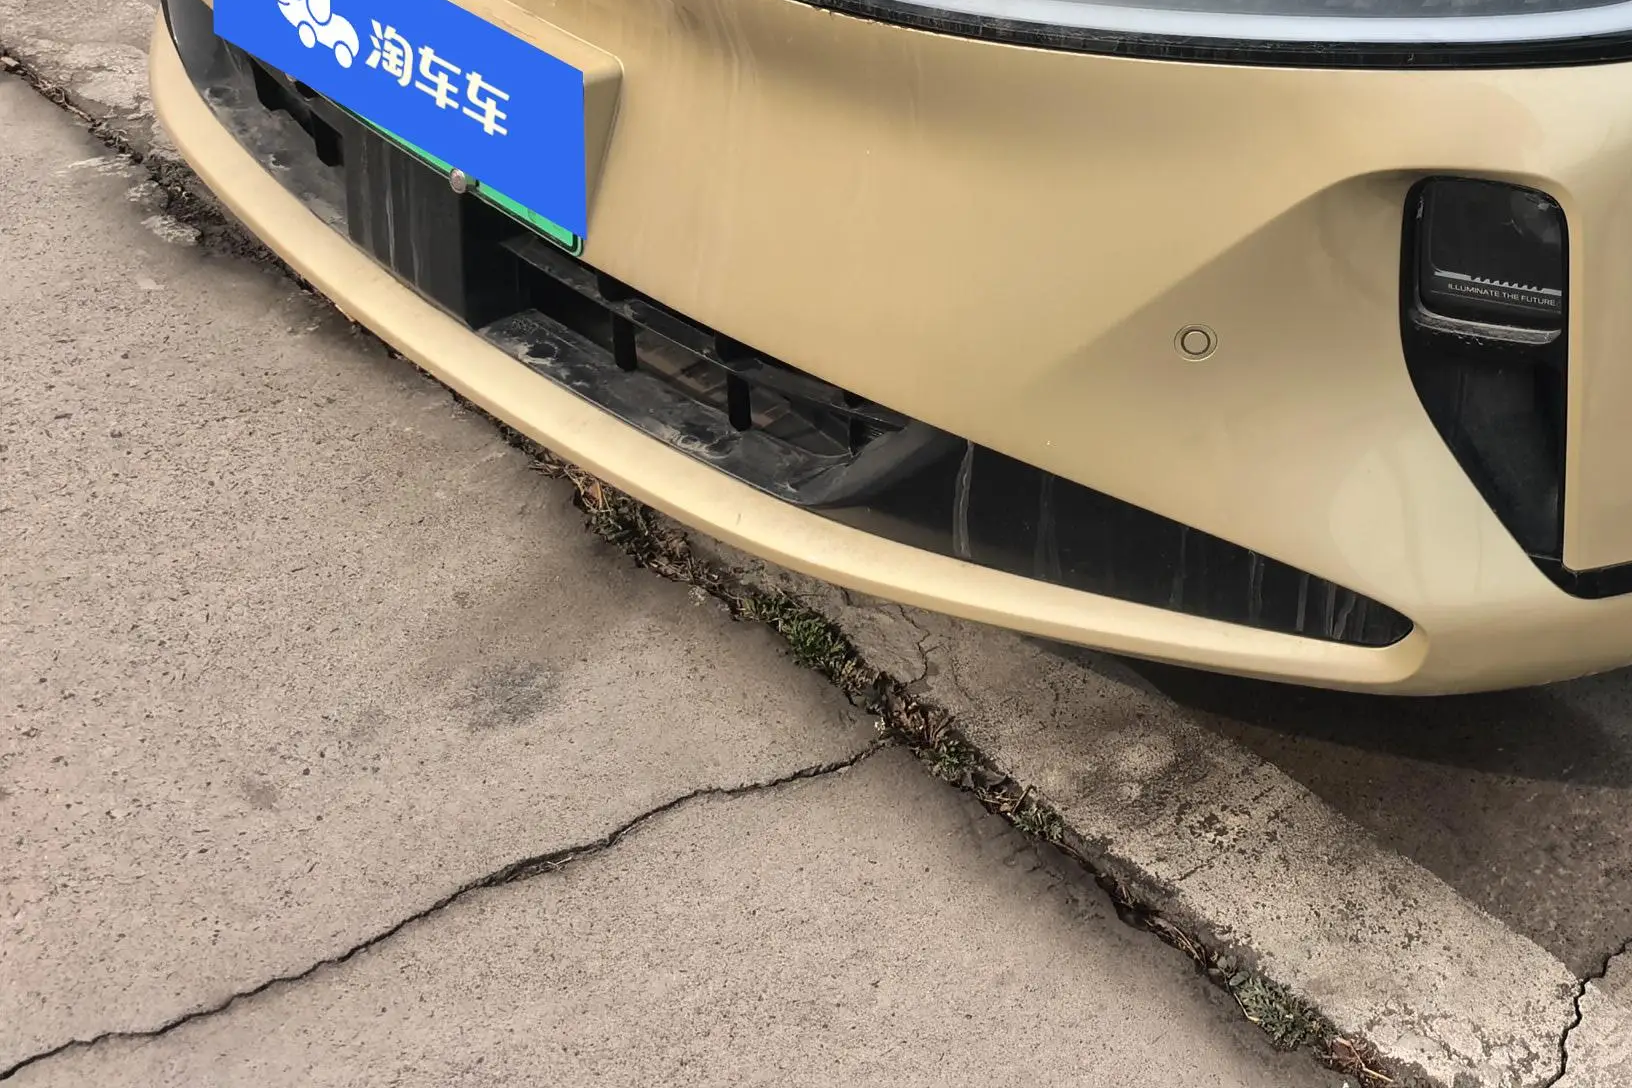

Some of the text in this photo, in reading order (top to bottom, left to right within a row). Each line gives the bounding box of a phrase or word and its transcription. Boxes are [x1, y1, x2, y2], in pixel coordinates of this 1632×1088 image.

[1447, 282, 1556, 307] ILLUMINATE THE FUTURE
